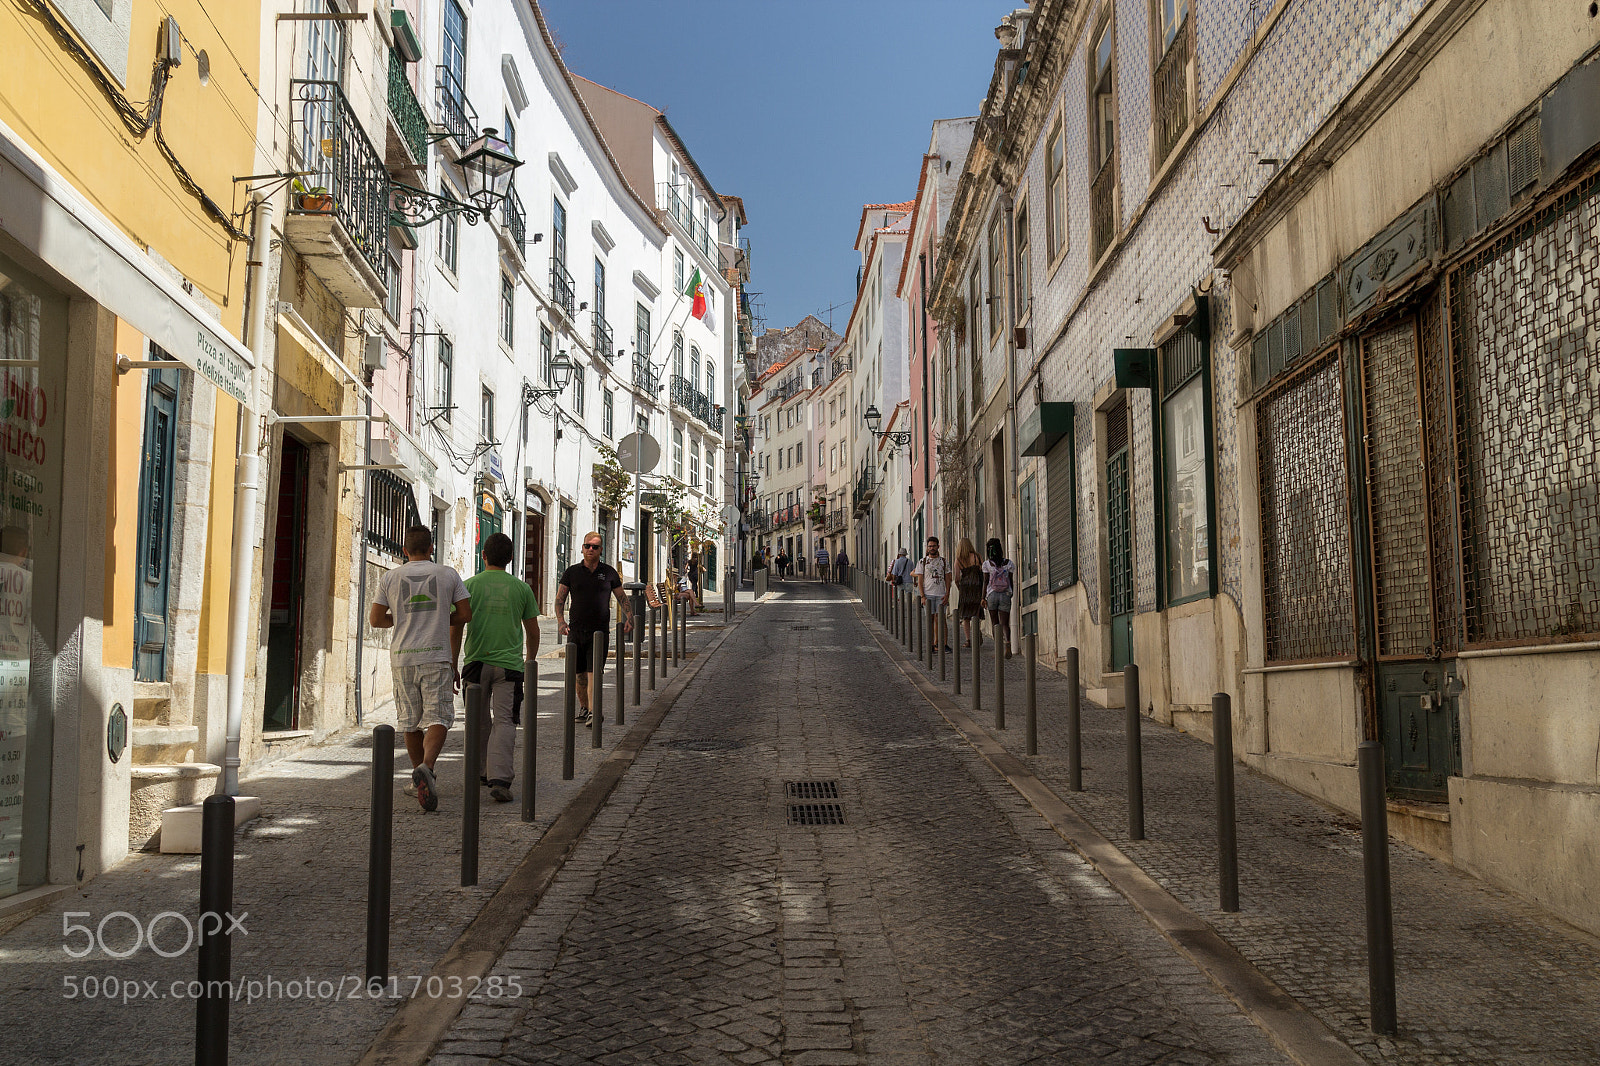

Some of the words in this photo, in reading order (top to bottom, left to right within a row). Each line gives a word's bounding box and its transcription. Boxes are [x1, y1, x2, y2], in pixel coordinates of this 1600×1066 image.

[197, 331, 217, 360] Pizza
[219, 352, 226, 367] al
[227, 358, 246, 383] taglio
[197, 358, 202, 371] e
[202, 360, 223, 387] delizie
[225, 376, 247, 404] italiane
[0, 422, 46, 466] ILICO
[13, 469, 43, 494] taglio
[8, 492, 43, 517] italiane
